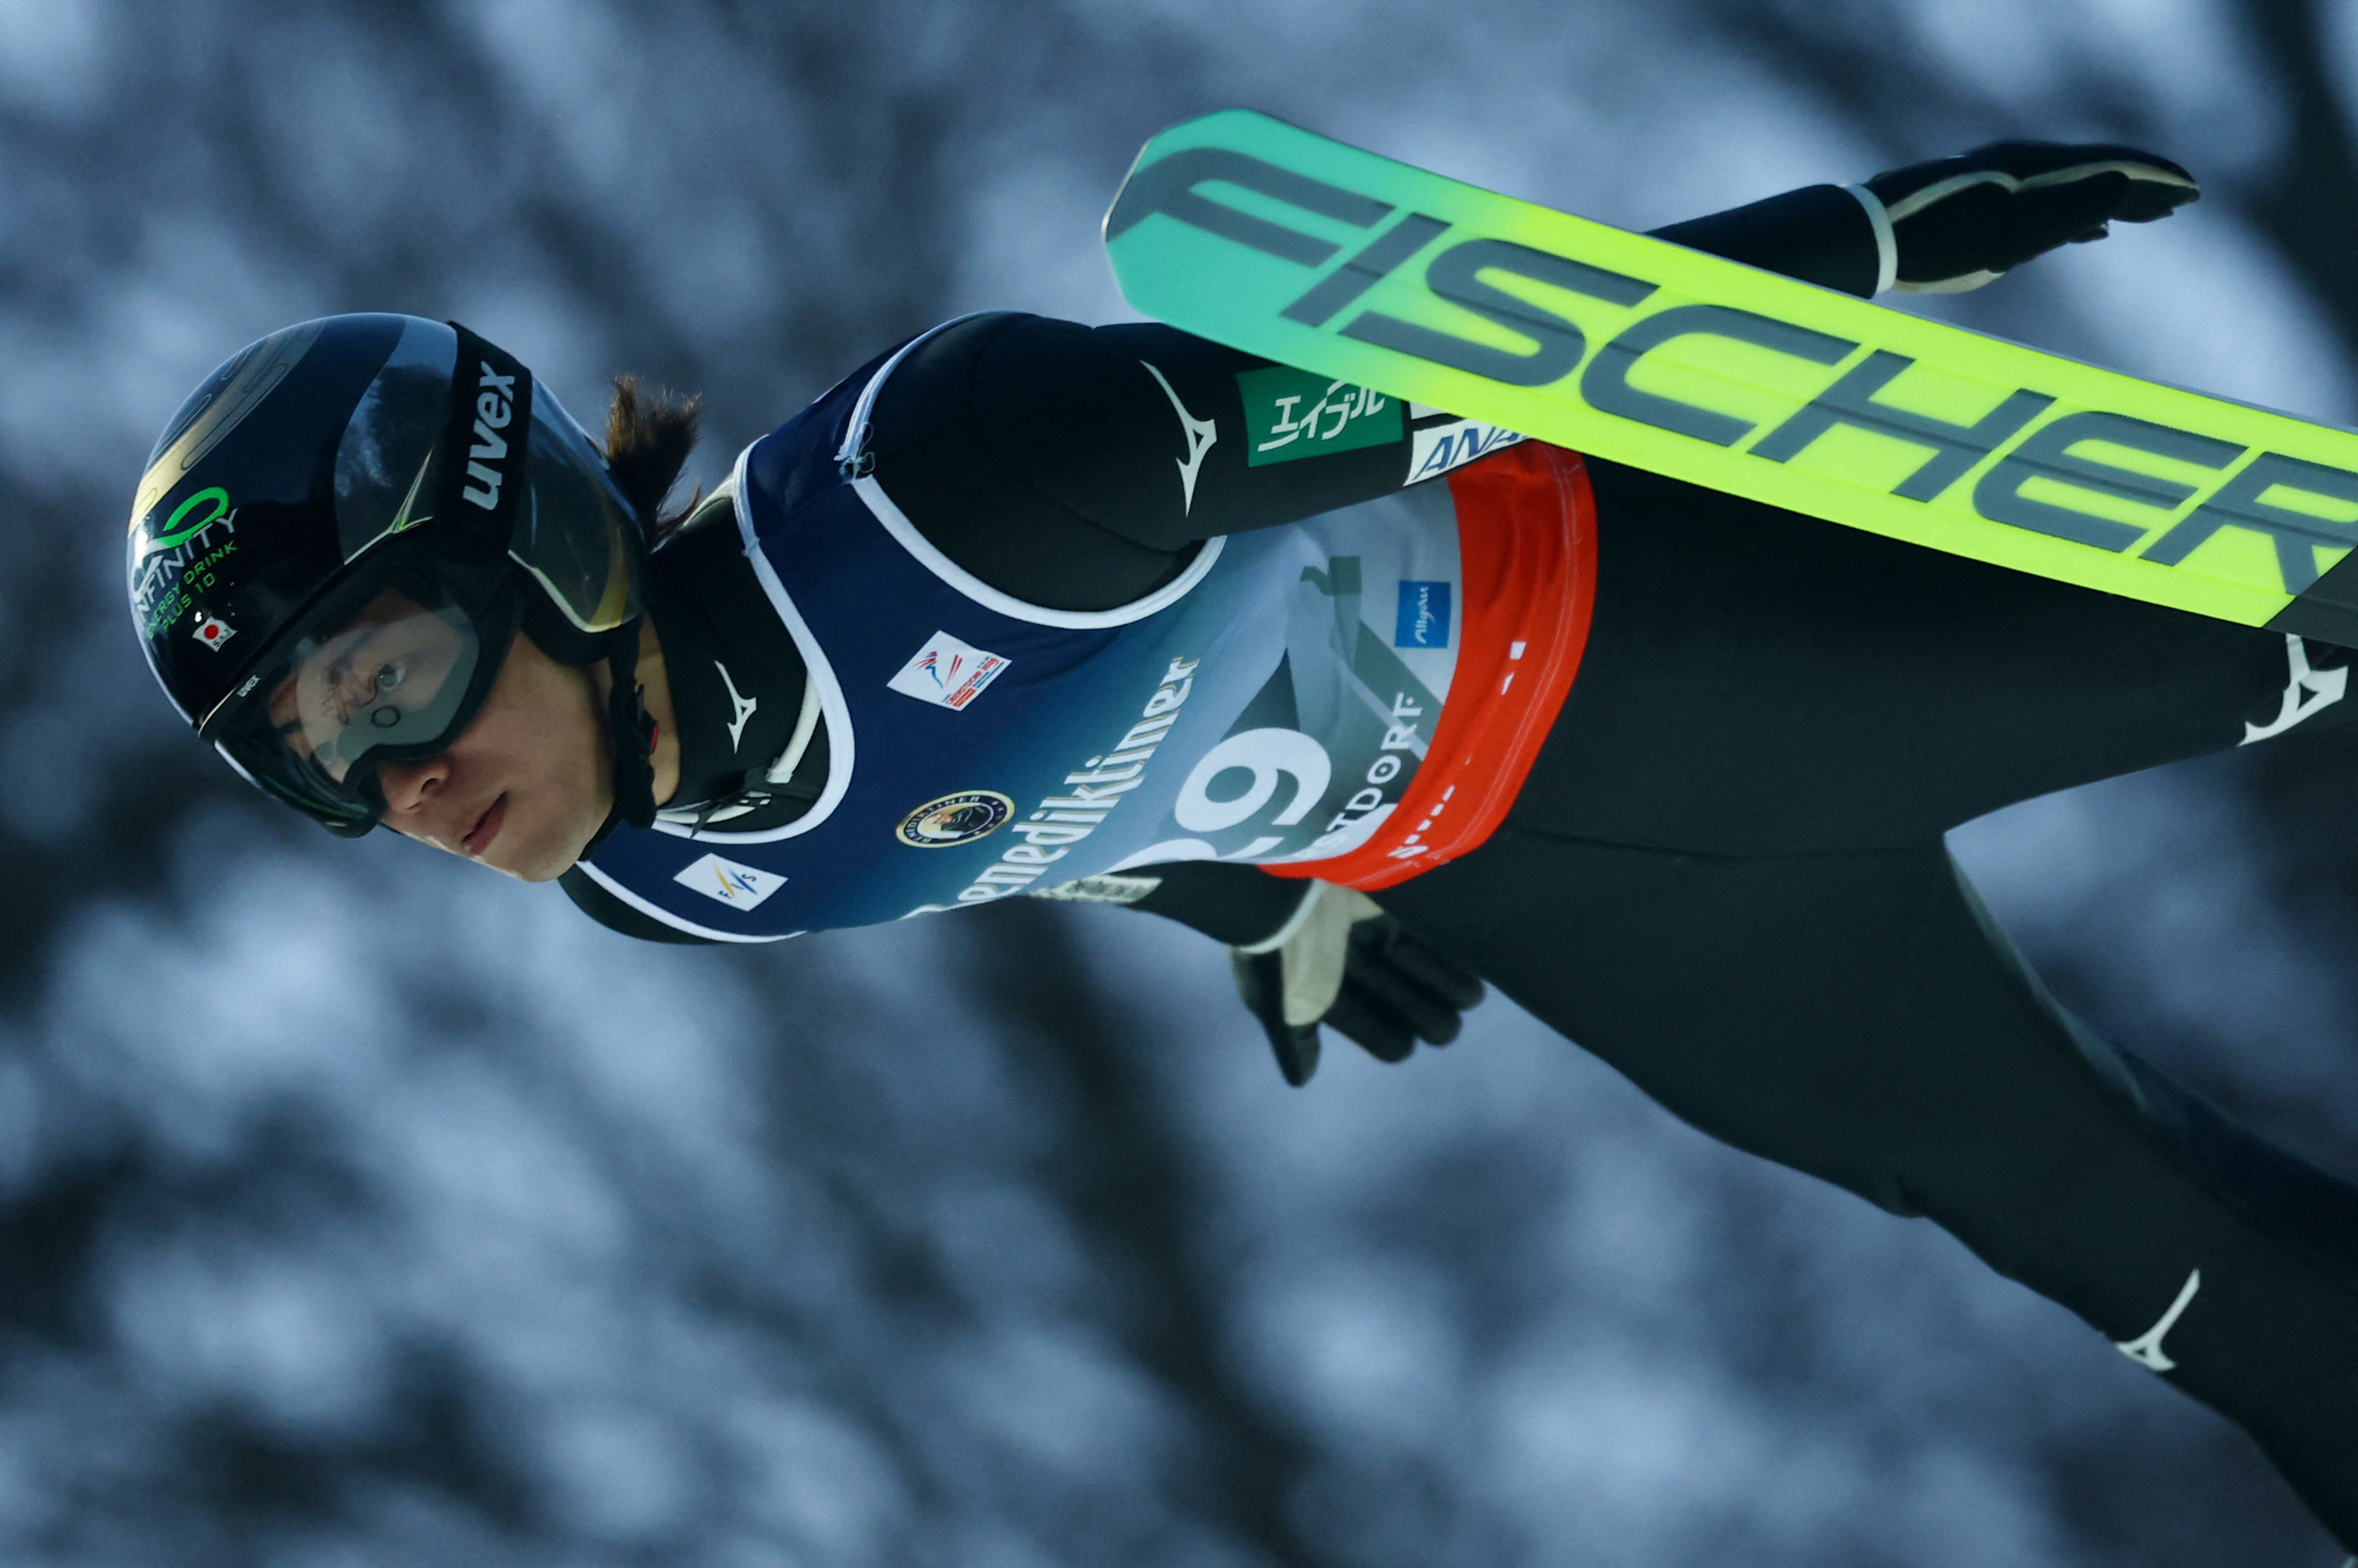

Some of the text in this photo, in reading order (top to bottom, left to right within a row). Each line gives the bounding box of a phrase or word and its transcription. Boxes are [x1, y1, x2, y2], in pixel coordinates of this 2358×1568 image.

[1106, 147, 2358, 596] FISCHER
[463, 360, 515, 510] uvex
[1257, 380, 1385, 452] エイブル
[136, 508, 239, 622] NFINITY
[183, 540, 238, 585] DRINK
[162, 593, 193, 633] PLUS
[718, 873, 757, 899] FIS
